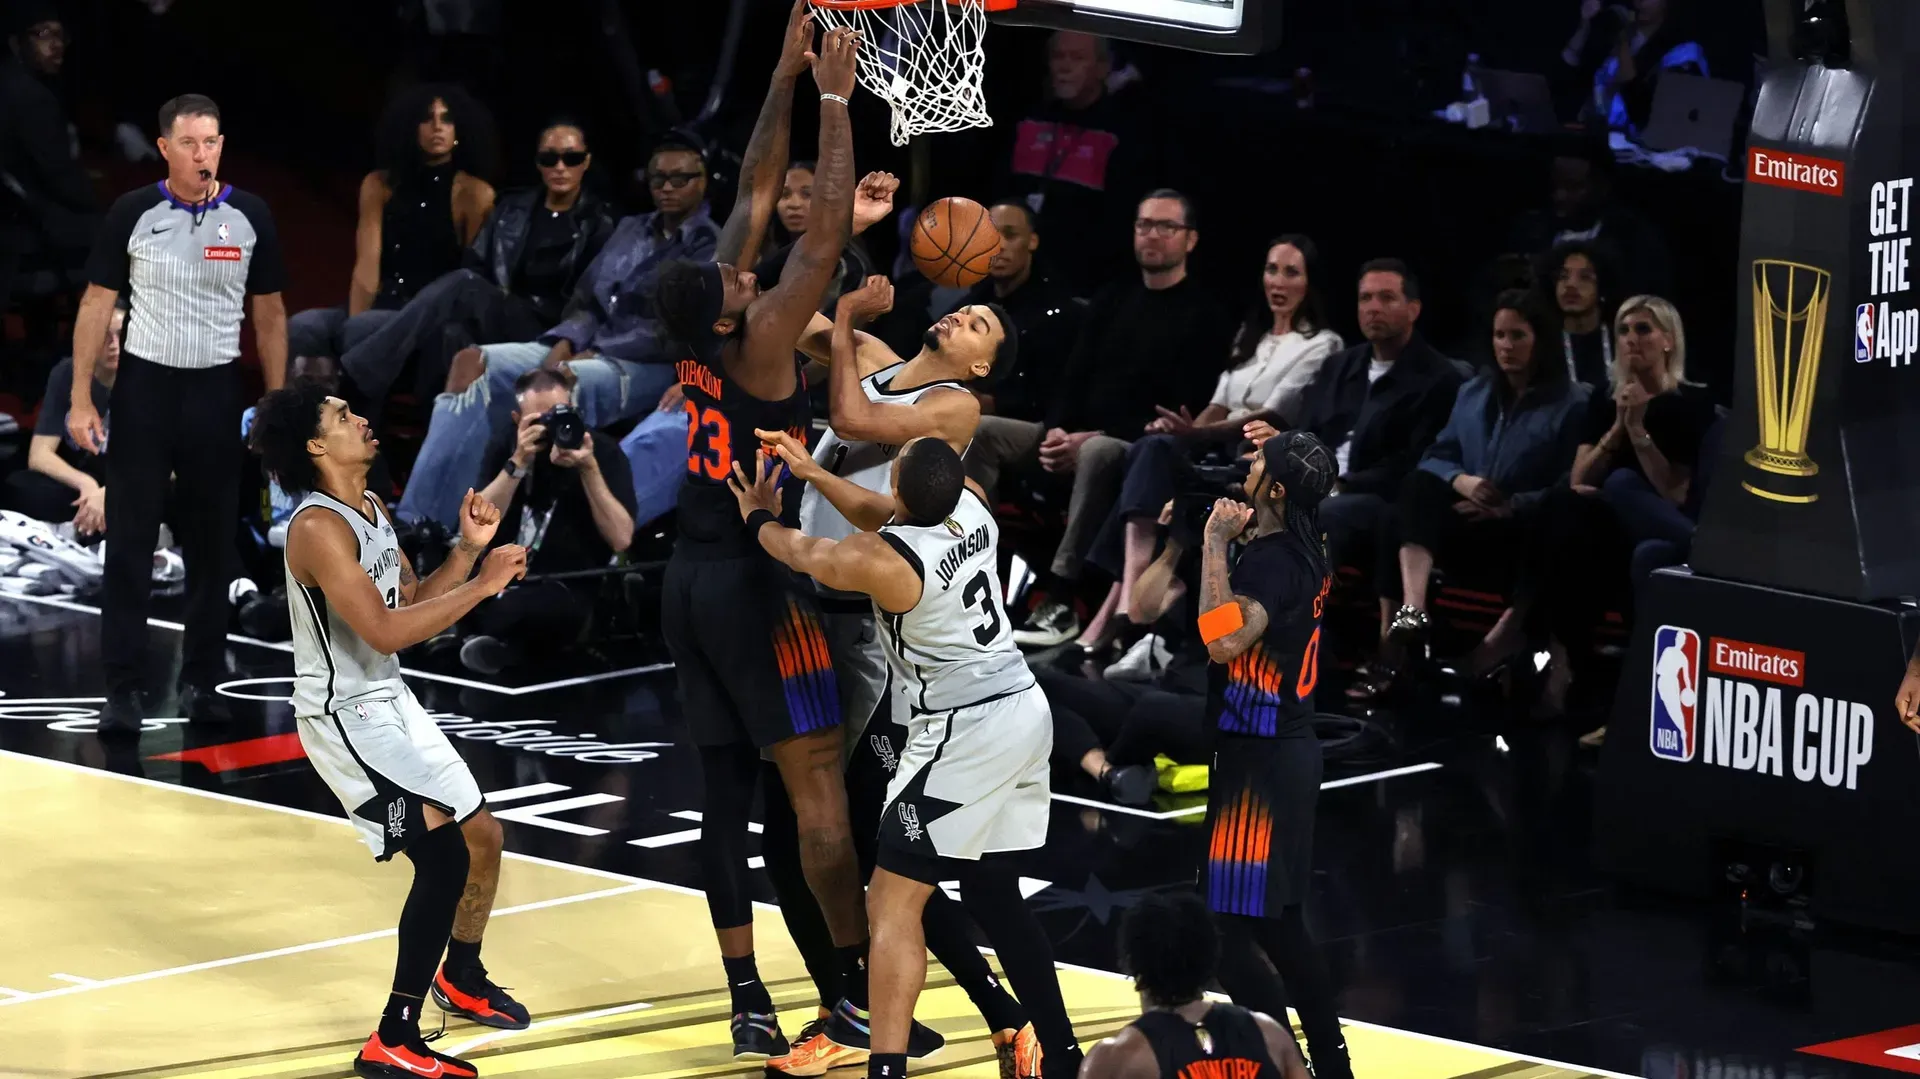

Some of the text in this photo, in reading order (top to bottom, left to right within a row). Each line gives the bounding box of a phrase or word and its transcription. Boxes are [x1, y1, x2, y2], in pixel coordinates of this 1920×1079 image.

[1754, 152, 1839, 189] Emirates
[1869, 177, 1914, 237] GET
[1868, 236, 1912, 296] THE
[1875, 301, 1919, 367] App
[685, 399, 731, 481] 23
[381, 547, 400, 571] ANTO
[935, 523, 990, 591] JOHNSON
[961, 568, 1001, 647] 3
[1716, 643, 1799, 677] Emirates
[1656, 728, 1678, 751] NBA
[1703, 676, 1875, 790] NBA CUP
